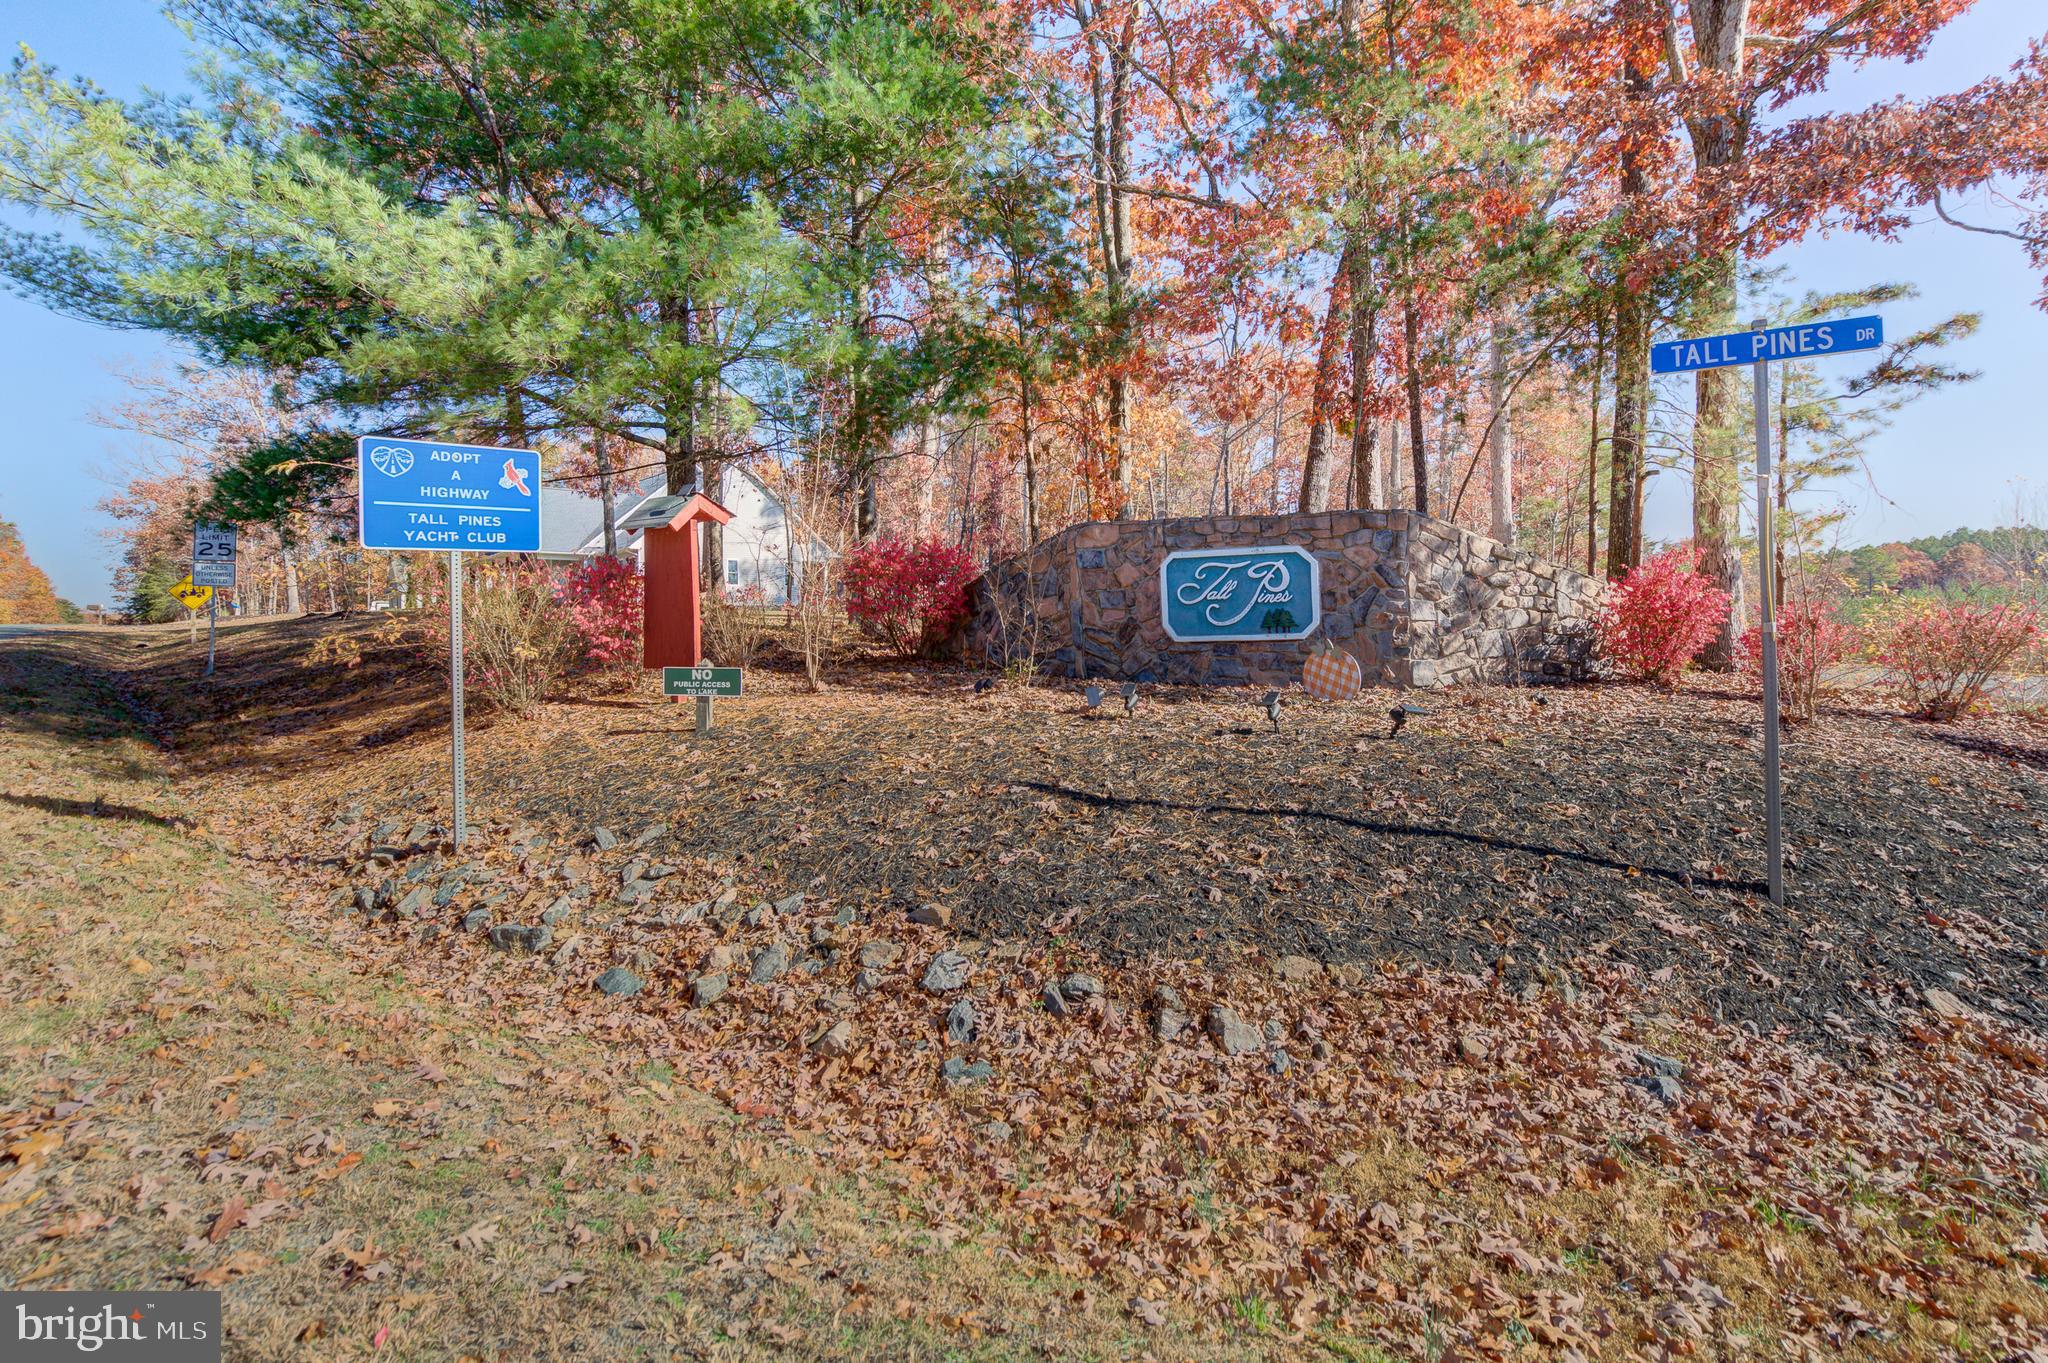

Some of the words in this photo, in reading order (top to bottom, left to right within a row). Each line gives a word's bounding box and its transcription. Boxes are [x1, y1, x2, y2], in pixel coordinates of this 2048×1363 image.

[1670, 339, 1737, 368] TALL
[1752, 326, 1834, 358] PINES
[1855, 327, 1875, 342] DR
[430, 451, 481, 464] ADOPT
[451, 470, 461, 480] A
[420, 486, 490, 500] HIGHWAY
[408, 513, 448, 525] TALL
[459, 515, 501, 527] PINES
[404, 530, 457, 542] YACHT
[467, 532, 506, 543] CLUB
[198, 542, 232, 556] 25
[1177, 560, 1251, 605] Tall
[1206, 559, 1293, 626] Pines
[692, 670, 712, 680] NO
